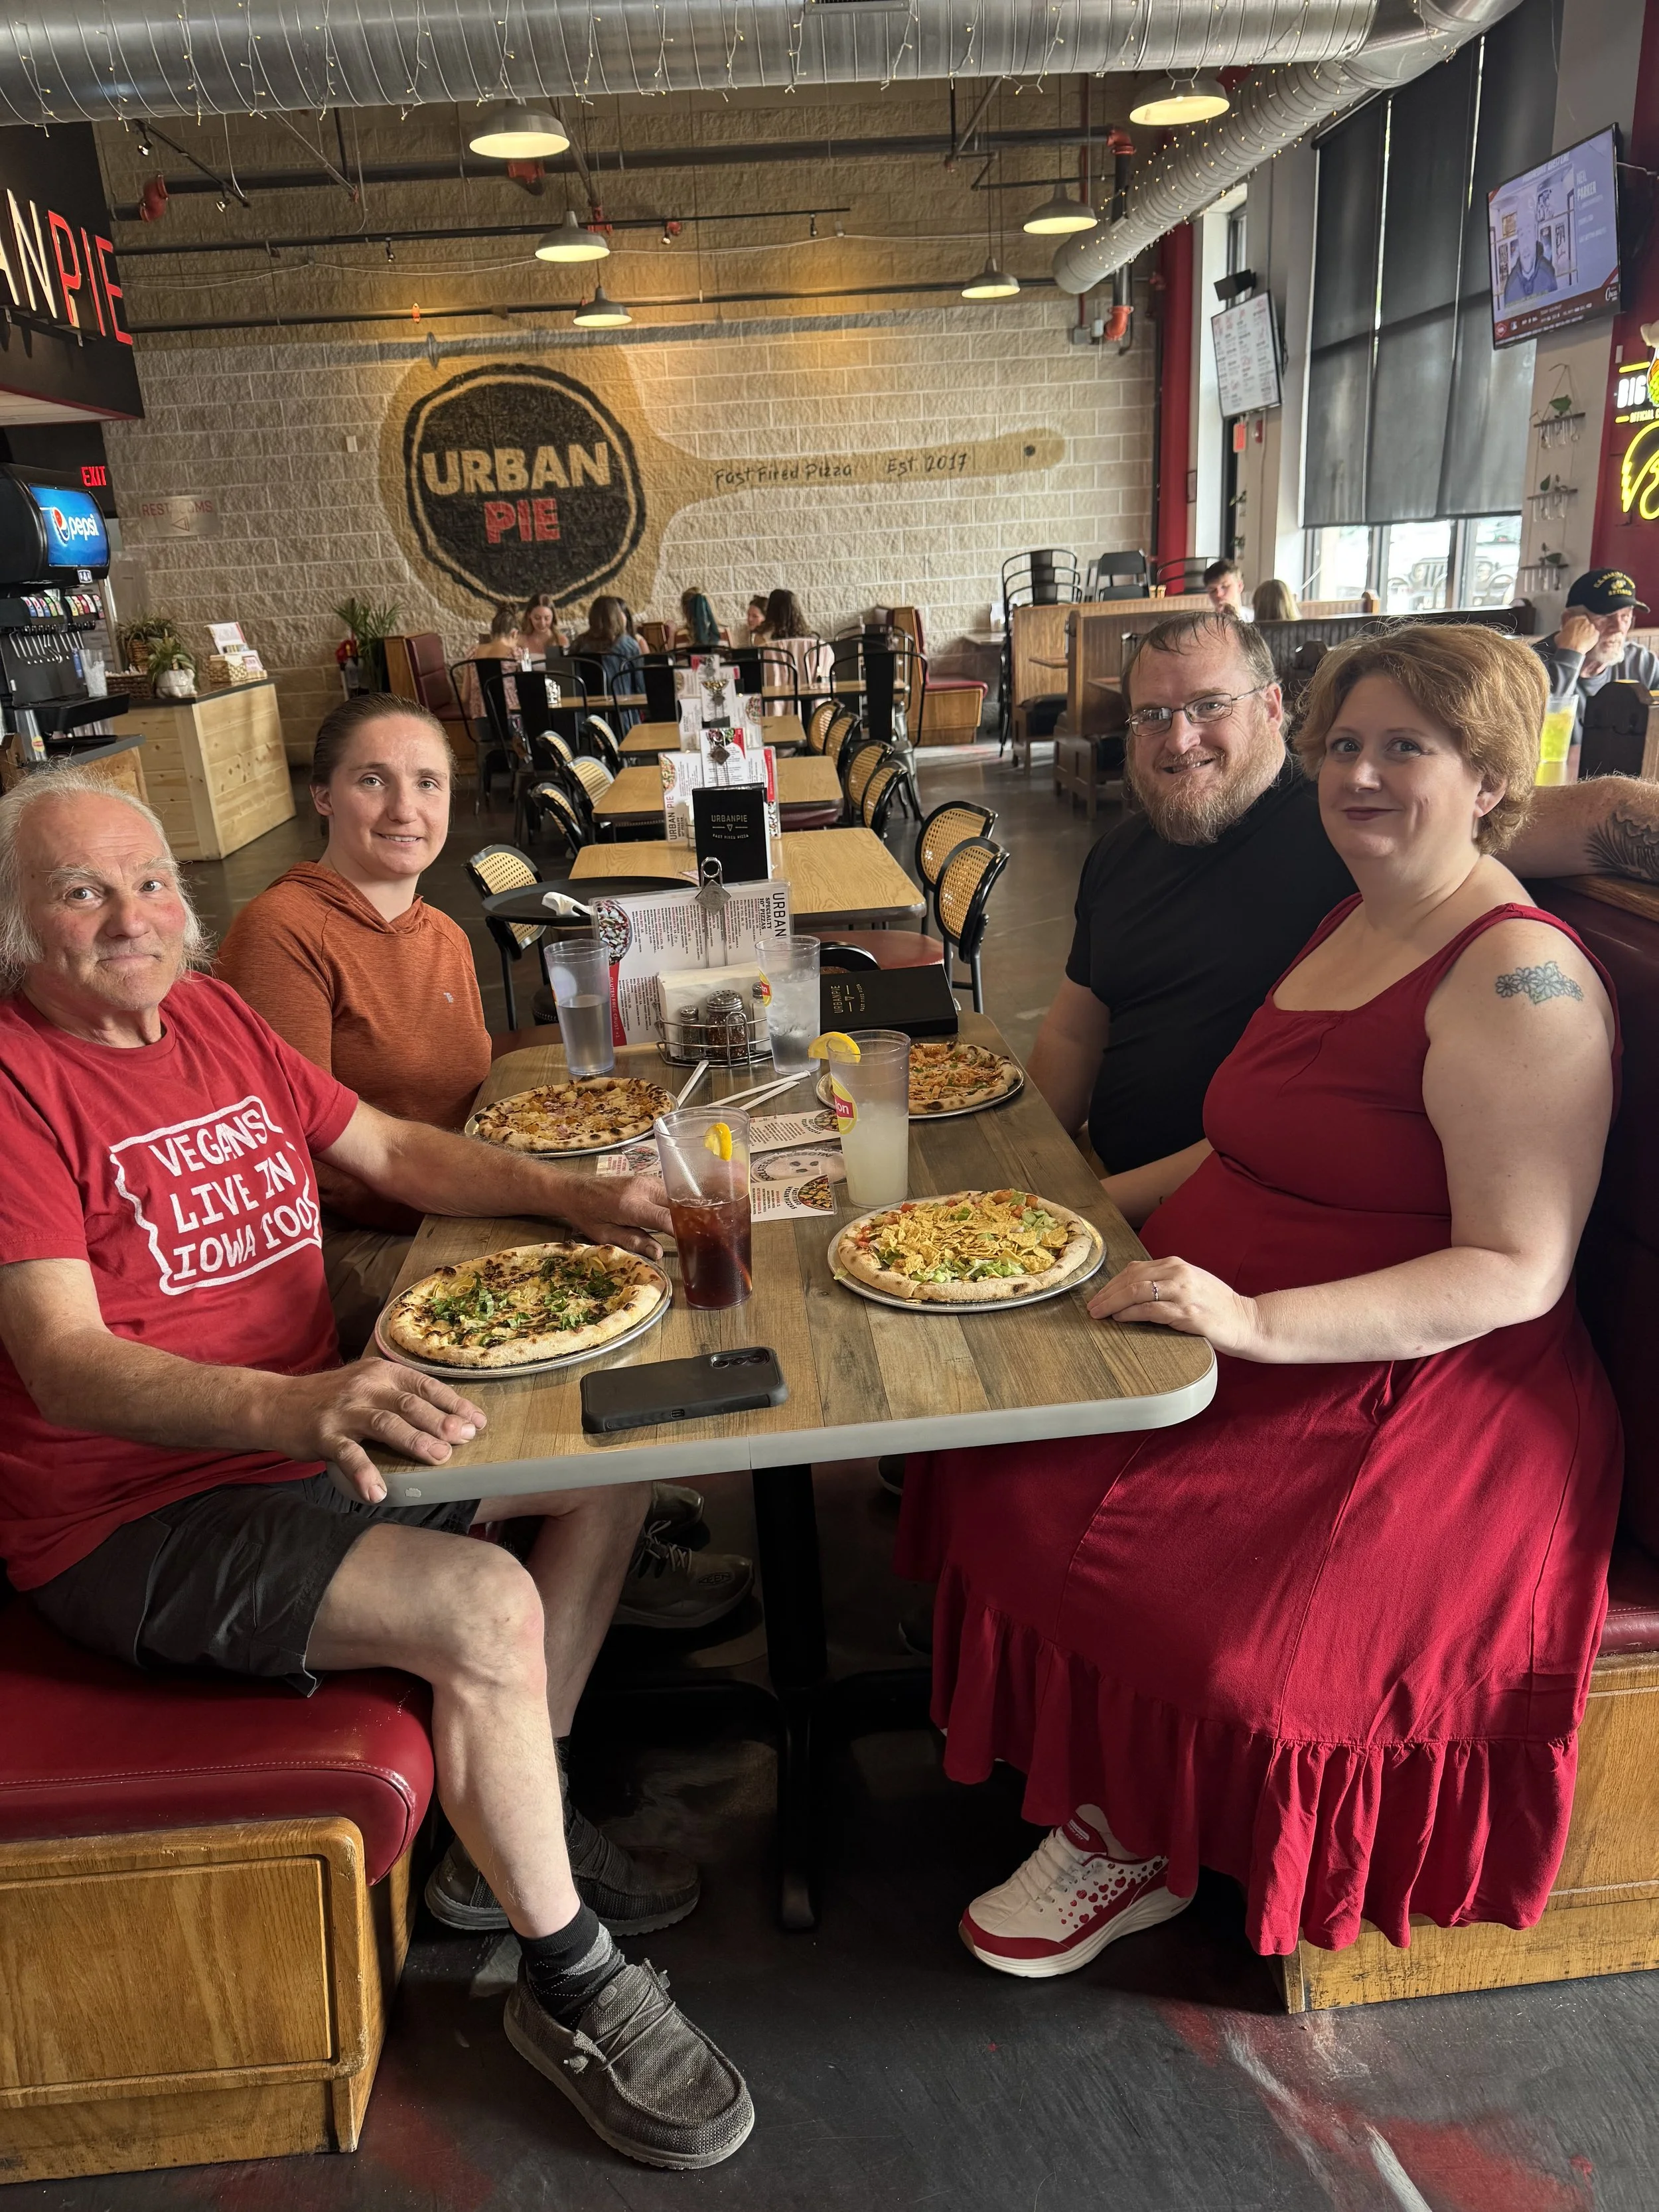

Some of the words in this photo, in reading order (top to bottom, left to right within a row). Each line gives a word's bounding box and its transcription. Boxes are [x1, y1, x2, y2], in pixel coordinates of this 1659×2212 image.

[1617, 374, 1647, 409] BIG
[81, 466, 106, 486] EXIT
[421, 442, 612, 496] URBAN
[925, 453, 968, 473] 2017
[69, 514, 100, 541] pepsi
[483, 498, 561, 544] PIE
[666, 796, 675, 808] PIE
[668, 812, 678, 840] URBAN
[772, 893, 787, 937] URBAN
[831, 985, 843, 1013] URBANPIE
[148, 1108, 268, 1177] VEGANS
[169, 1173, 259, 1234] LIVE
[253, 1151, 297, 1199] IN
[784, 1186, 793, 1198] VEGAN
[784, 1198, 797, 1209] PIZZAS
[792, 1196, 802, 1205] FIRED
[173, 1224, 256, 1281] IOWA
